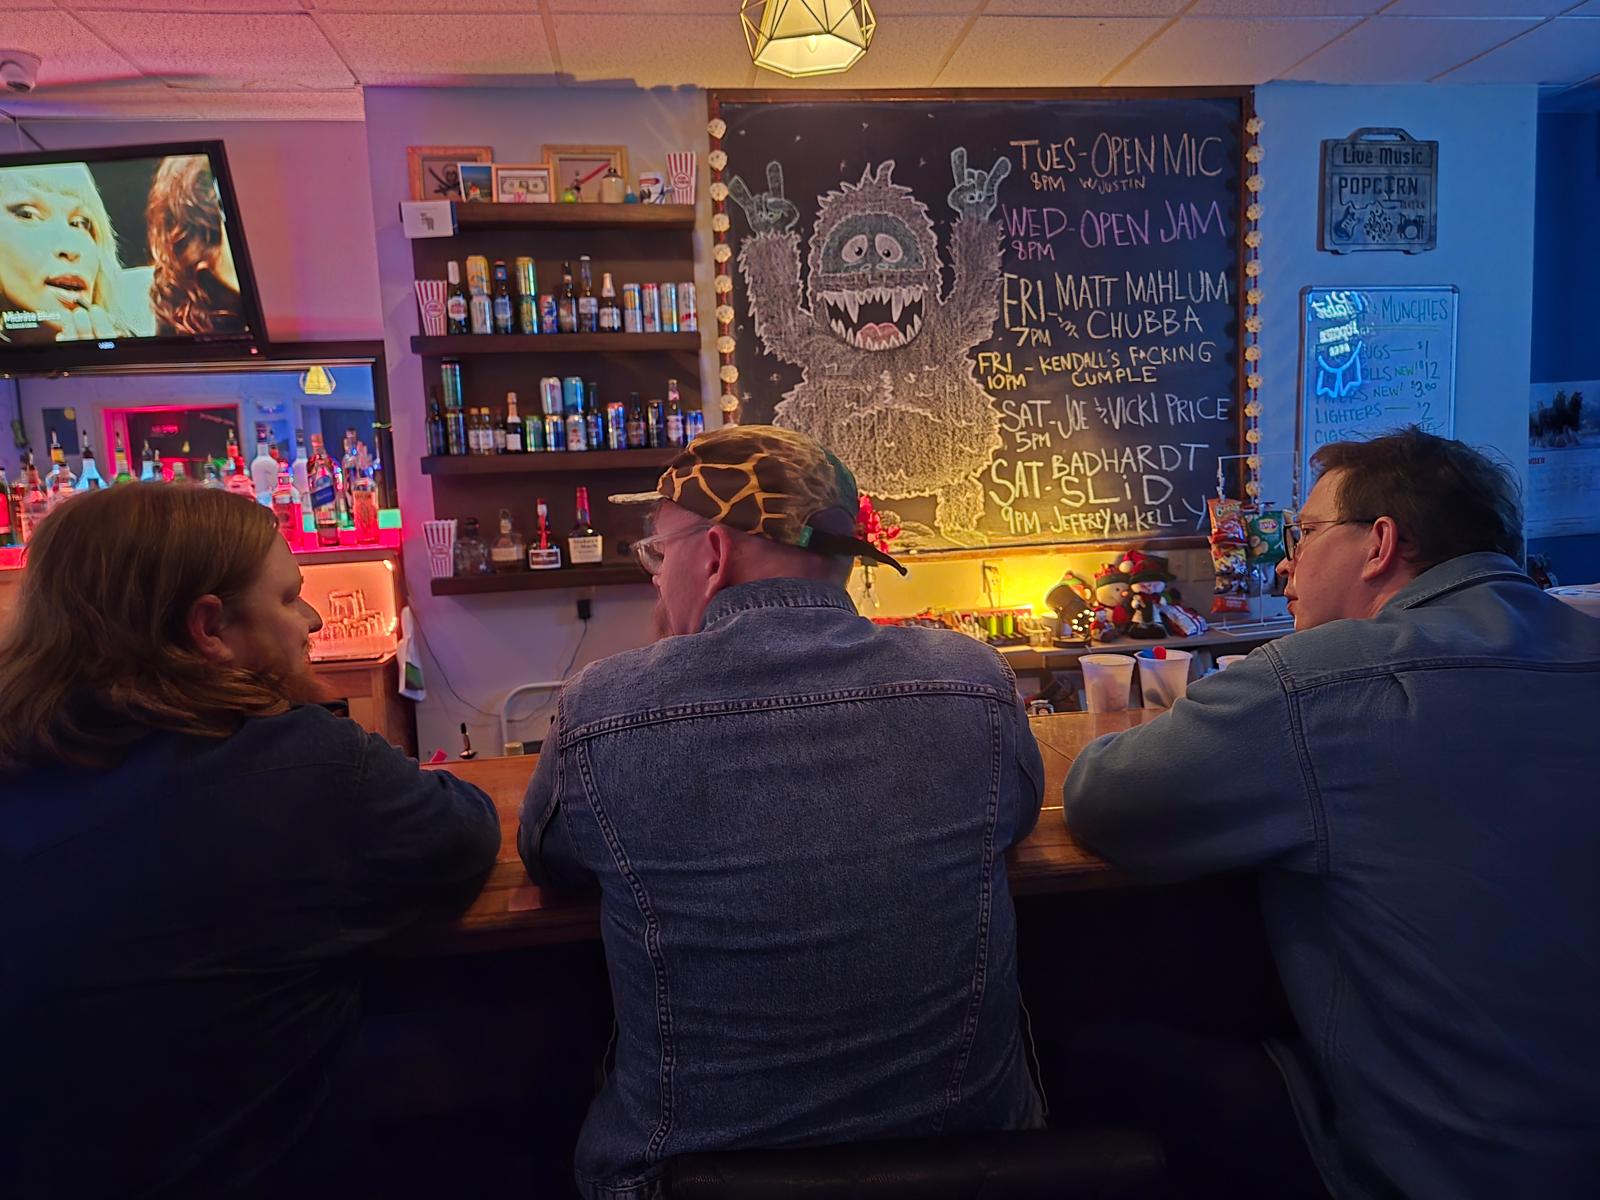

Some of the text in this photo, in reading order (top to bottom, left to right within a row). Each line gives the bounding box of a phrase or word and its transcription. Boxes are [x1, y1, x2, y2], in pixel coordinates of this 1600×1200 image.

[1163, 133, 1222, 176] MIC
[1343, 145, 1423, 165] Live Music
[1030, 172, 1065, 192] 8PM
[1159, 200, 1226, 243] JAM
[1011, 240, 1055, 261] 8PM
[1054, 271, 1119, 312] MATT
[1126, 270, 1229, 305] MAHLUM
[1382, 296, 1449, 323] MUNCHIES
[1010, 327, 1051, 347] 7PM
[1087, 305, 1203, 340] CHUBBA
[986, 366, 1157, 391] 10PM CUMPLE
[1107, 393, 1160, 431] VICKI
[1165, 393, 1231, 426] PRICE
[1315, 402, 1383, 424] LIGHTERS
[1015, 431, 1051, 453] 5PM
[1052, 442, 1209, 480] BADHARDT
[1001, 505, 1041, 535] 9PM
[1050, 505, 1111, 539] JEFFREY
[1135, 494, 1208, 532] KELLY
